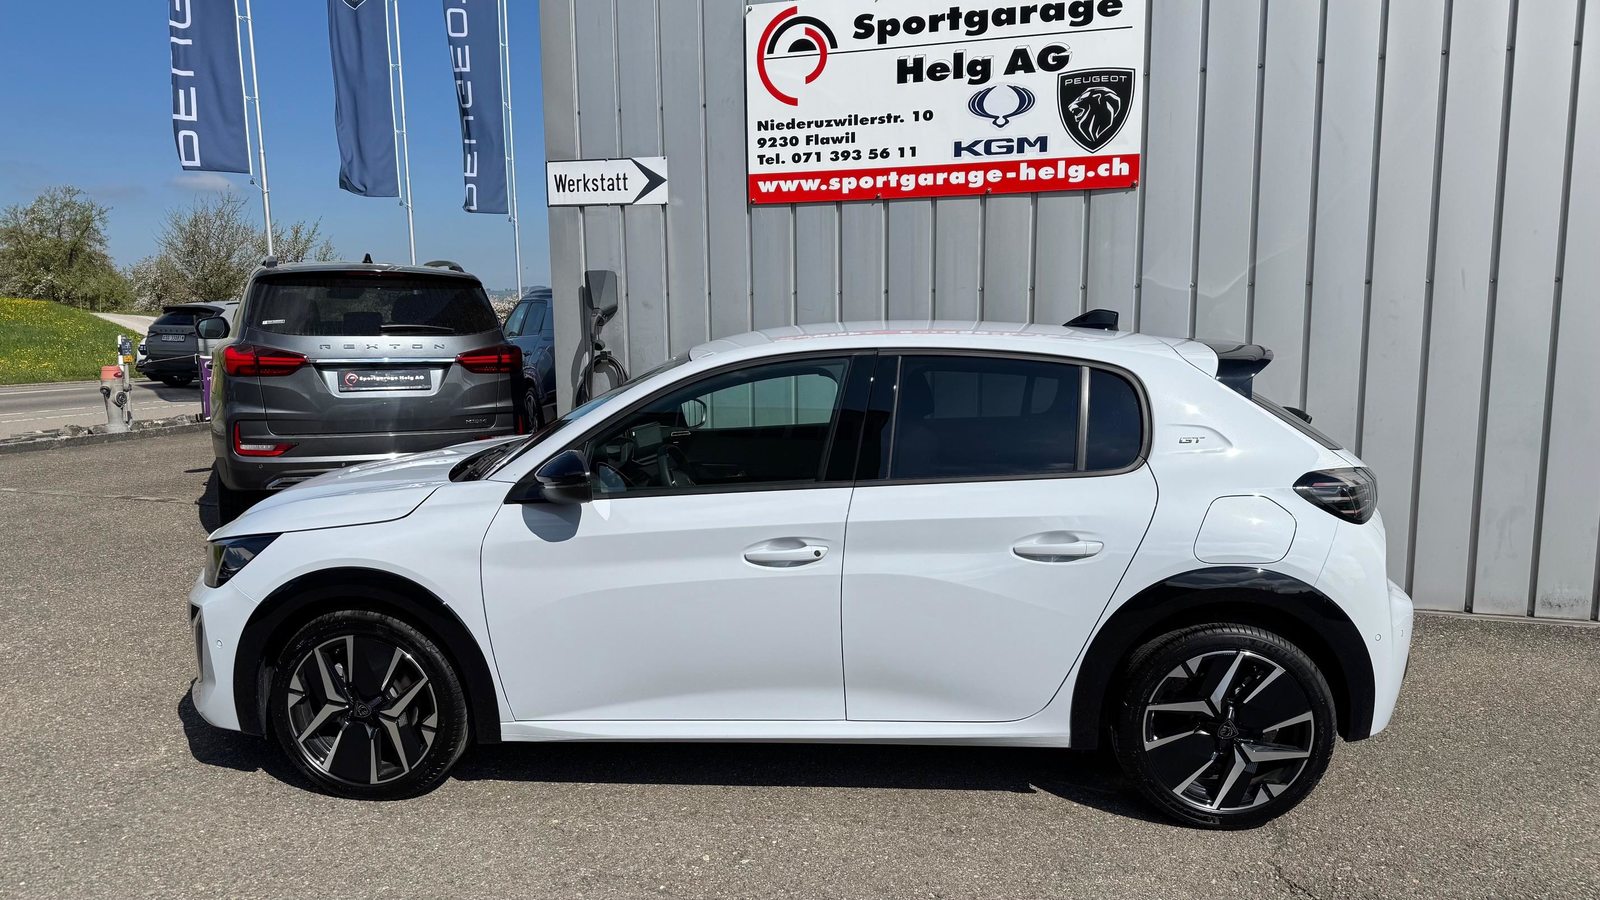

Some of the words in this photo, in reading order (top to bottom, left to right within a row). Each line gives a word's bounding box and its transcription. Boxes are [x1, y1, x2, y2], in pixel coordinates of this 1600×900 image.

[853, 0, 1123, 44] Sportgarage
[896, 49, 994, 85] Helg
[1003, 42, 1073, 76] AG
[1064, 75, 1128, 86] PEUGEOT
[757, 113, 905, 132] Niederuzwilerstr.
[912, 110, 934, 122] 10
[757, 136, 799, 148] 9230
[805, 132, 856, 146] Flawil
[953, 135, 1048, 158] KGM
[757, 153, 786, 165] Tel.
[791, 151, 822, 164] 071
[829, 149, 862, 162] 393
[868, 147, 890, 160] 56
[897, 146, 917, 158] 11
[554, 172, 628, 193] Werkstatt
[757, 157, 1130, 194] www.sportgarage-helg.ch
[1178, 436, 1206, 444] GT
